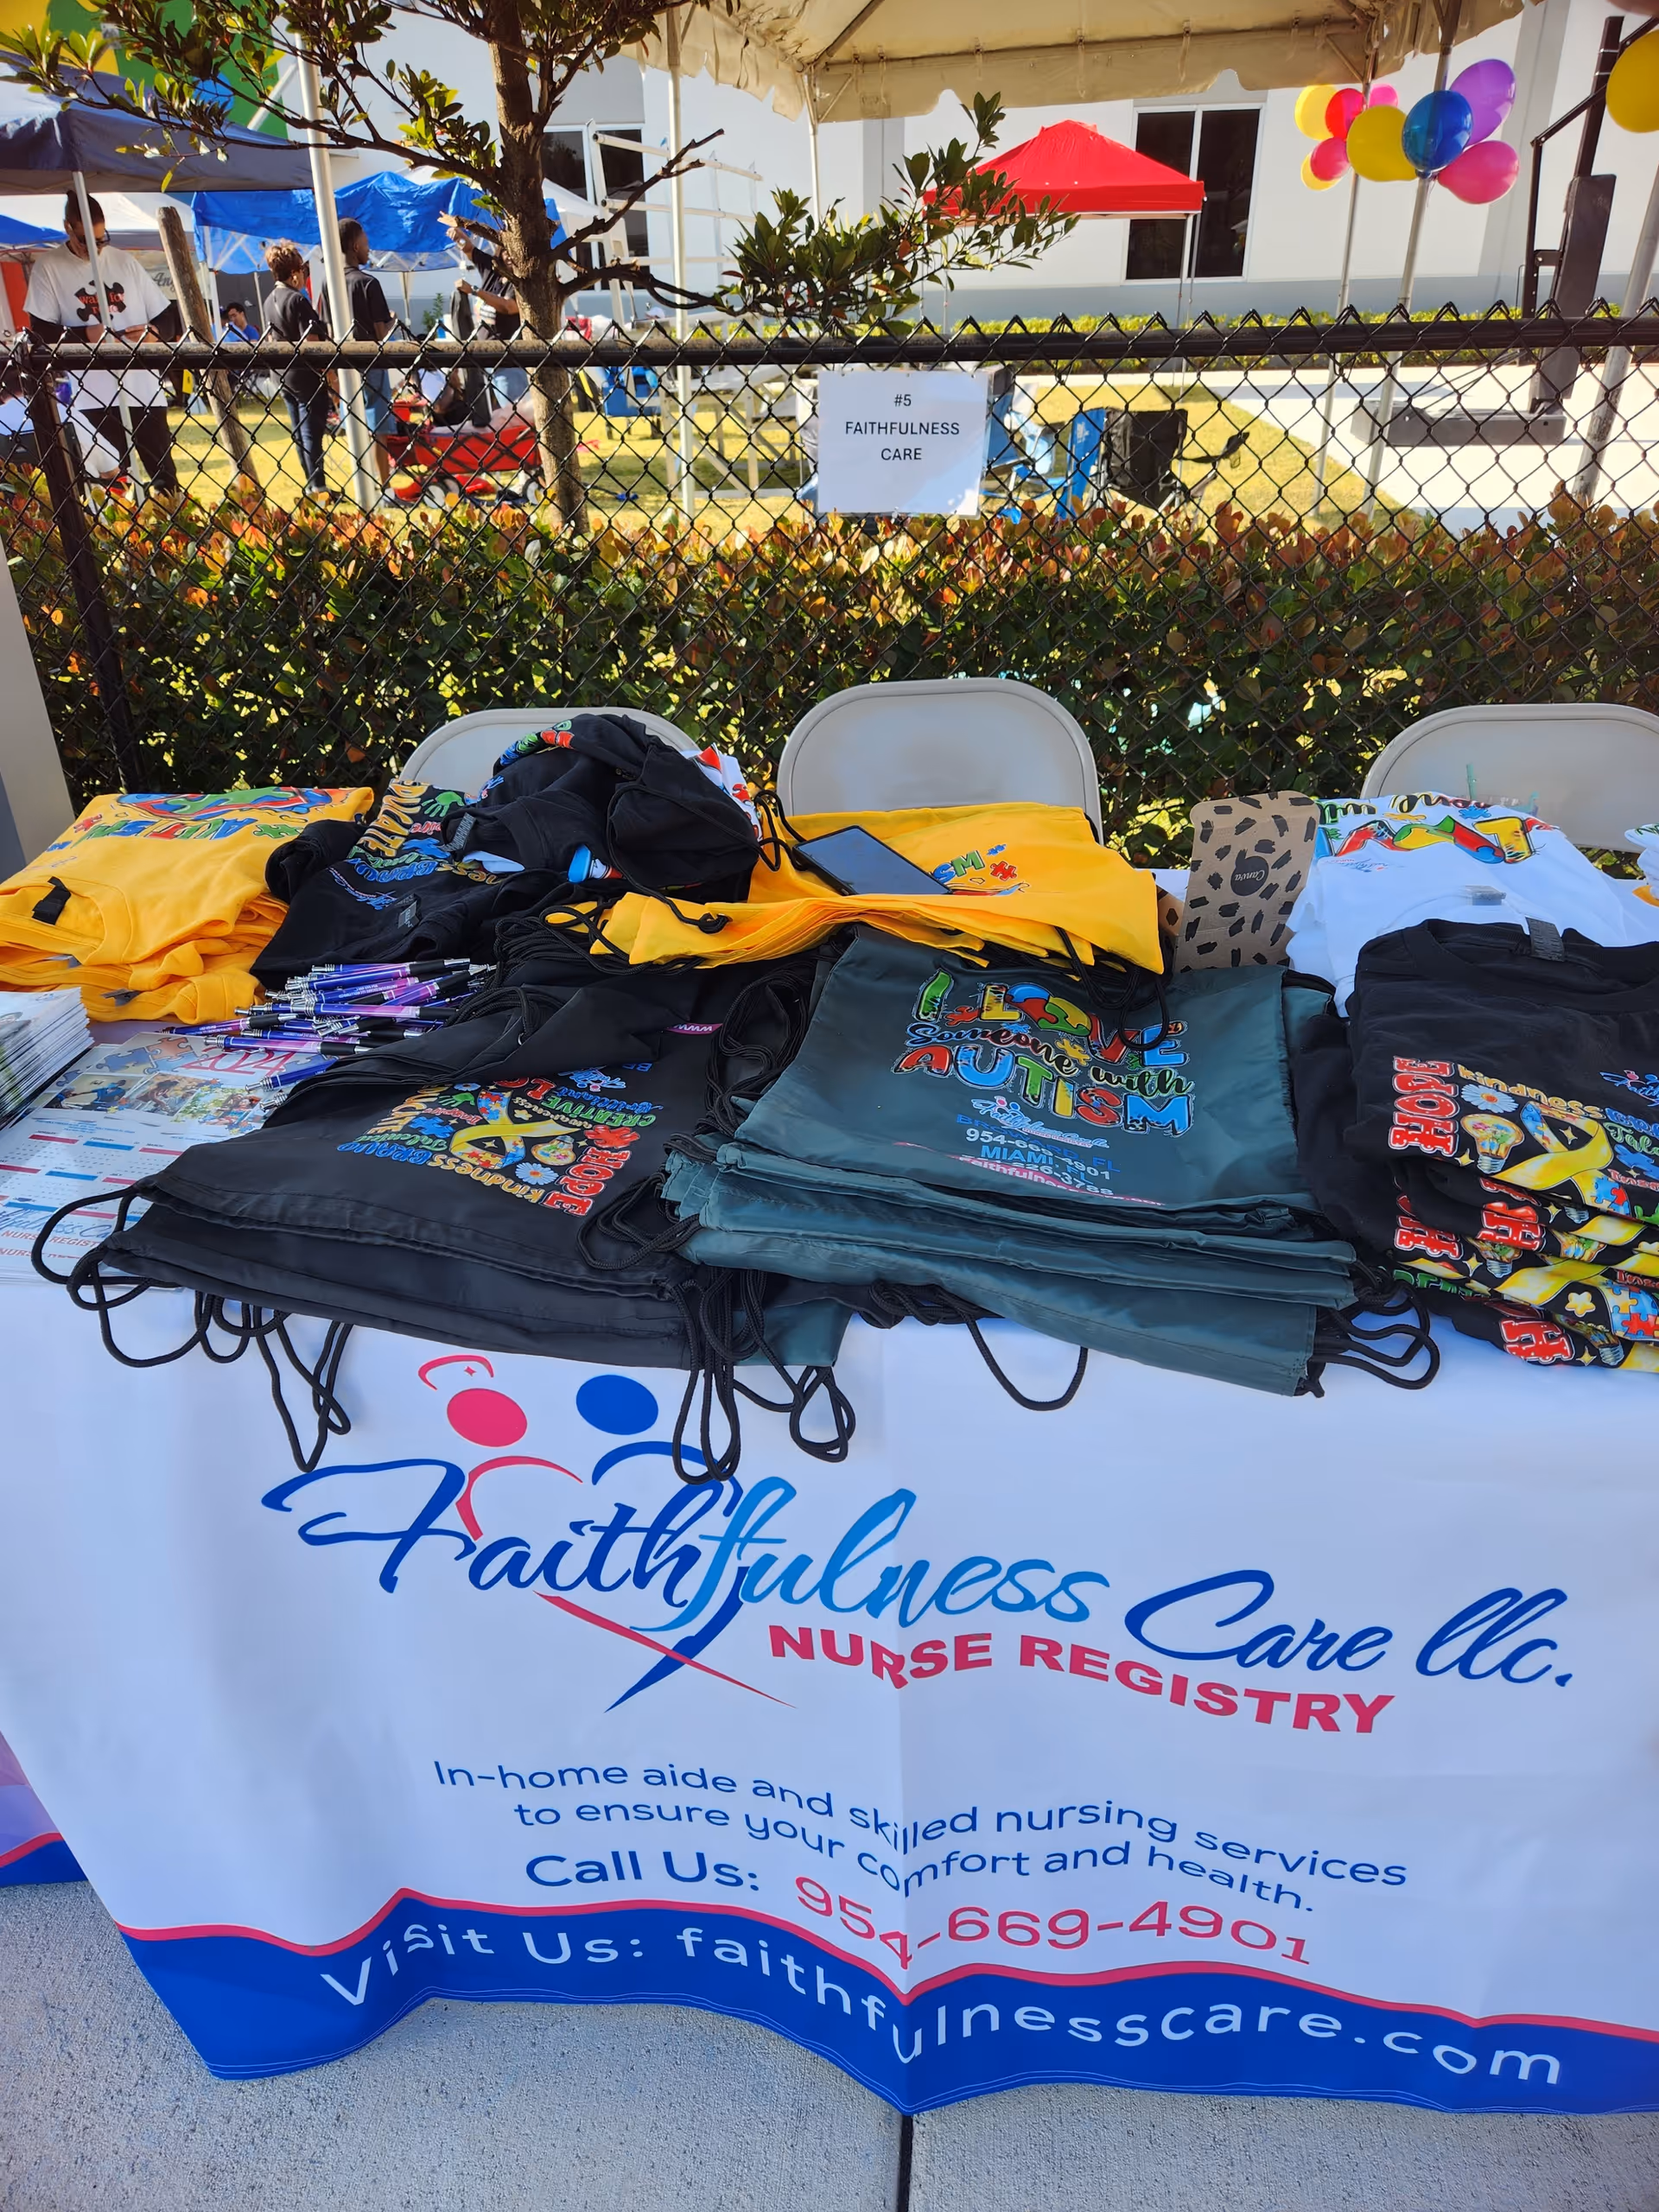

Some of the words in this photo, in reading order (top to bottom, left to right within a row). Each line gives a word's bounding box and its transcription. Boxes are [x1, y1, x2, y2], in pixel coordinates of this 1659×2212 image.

[893, 394, 912, 407] #5
[845, 421, 960, 435] FAITHFULNESS
[880, 448, 922, 461] CARE
[73, 817, 257, 847] AUTISM
[1234, 869, 1265, 882] Canva
[181, 1046, 297, 1077] 2024
[906, 1022, 1081, 1077] Someone
[1090, 1064, 1194, 1098] with
[512, 1096, 593, 1129] awareness
[553, 1086, 664, 1114] Brilliant
[892, 1044, 1196, 1136] AUTISM
[1388, 1056, 1460, 1156] HOPE
[1457, 1064, 1606, 1120] kindness
[427, 1153, 546, 1205] kindness
[540, 1146, 632, 1217] HOPE
[980, 1145, 1060, 1168] MIAMI,
[1092, 1155, 1121, 1173] FL
[2, 1230, 40, 1241] NURS
[261, 1459, 1110, 1631] Faithfulness
[1124, 1569, 1394, 1672] Care
[1415, 1586, 1573, 1688] llc.
[768, 1624, 993, 1690] NURSE
[1020, 1634, 1396, 1734] REGISTRY
[434, 1760, 629, 1789] In-home
[643, 1764, 737, 1793] aide
[752, 1779, 834, 1818] and
[849, 1804, 978, 1855] skilled
[995, 1800, 1179, 1843] nursing
[1193, 1829, 1408, 1886] services
[514, 1802, 561, 1827] to
[575, 1802, 730, 1827] ensure
[744, 1813, 845, 1859] your
[856, 1850, 1030, 1898] comfort
[1043, 1840, 1130, 1874] and
[1147, 1845, 1313, 1912] health.
[524, 1850, 643, 1887] Call
[662, 1851, 760, 1891] Us:
[794, 1875, 1311, 1971] 954-669-4901
[320, 1923, 495, 2006] Visit
[521, 1931, 645, 1965] Us:
[675, 1926, 1560, 2084] faithfulnesscare.com
